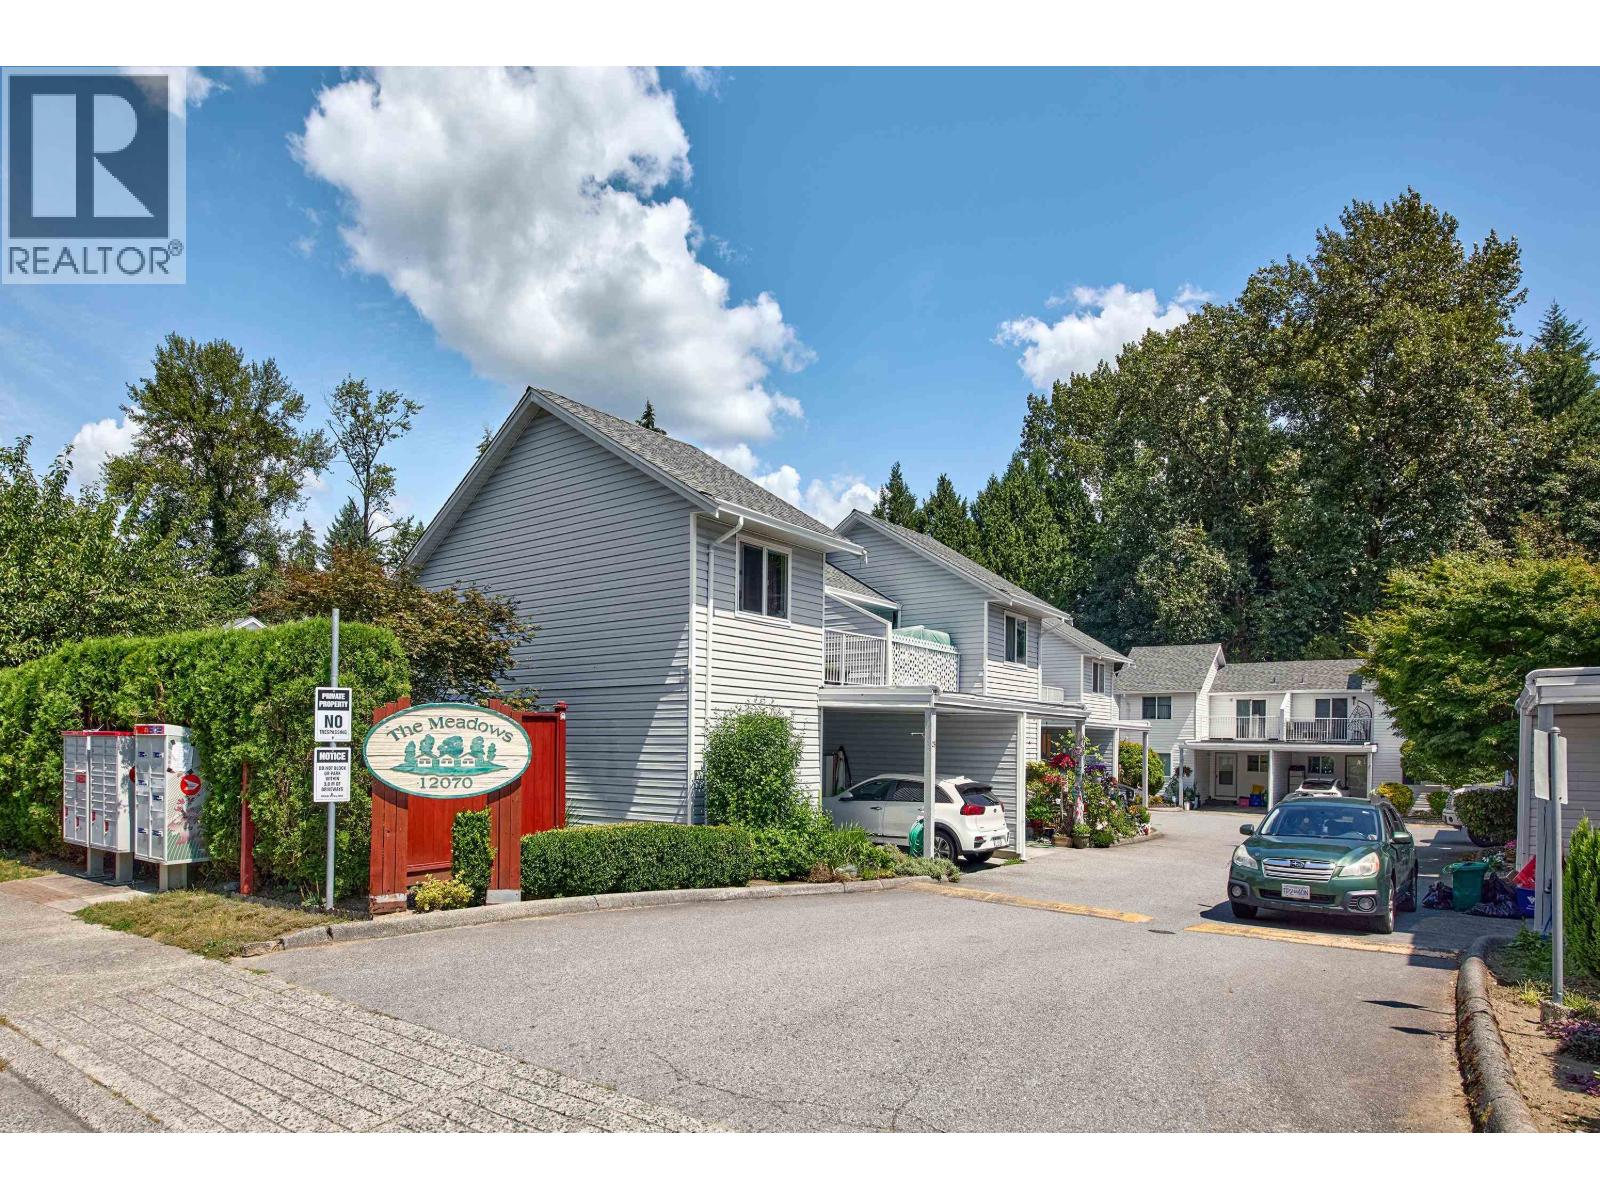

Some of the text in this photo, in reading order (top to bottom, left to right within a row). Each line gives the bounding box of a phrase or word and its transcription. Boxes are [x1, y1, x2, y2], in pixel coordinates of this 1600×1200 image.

[324, 714, 343, 729] NO
[386, 717, 514, 743] The Meadows
[320, 752, 346, 760] NOTICE
[418, 777, 474, 790] 12070
